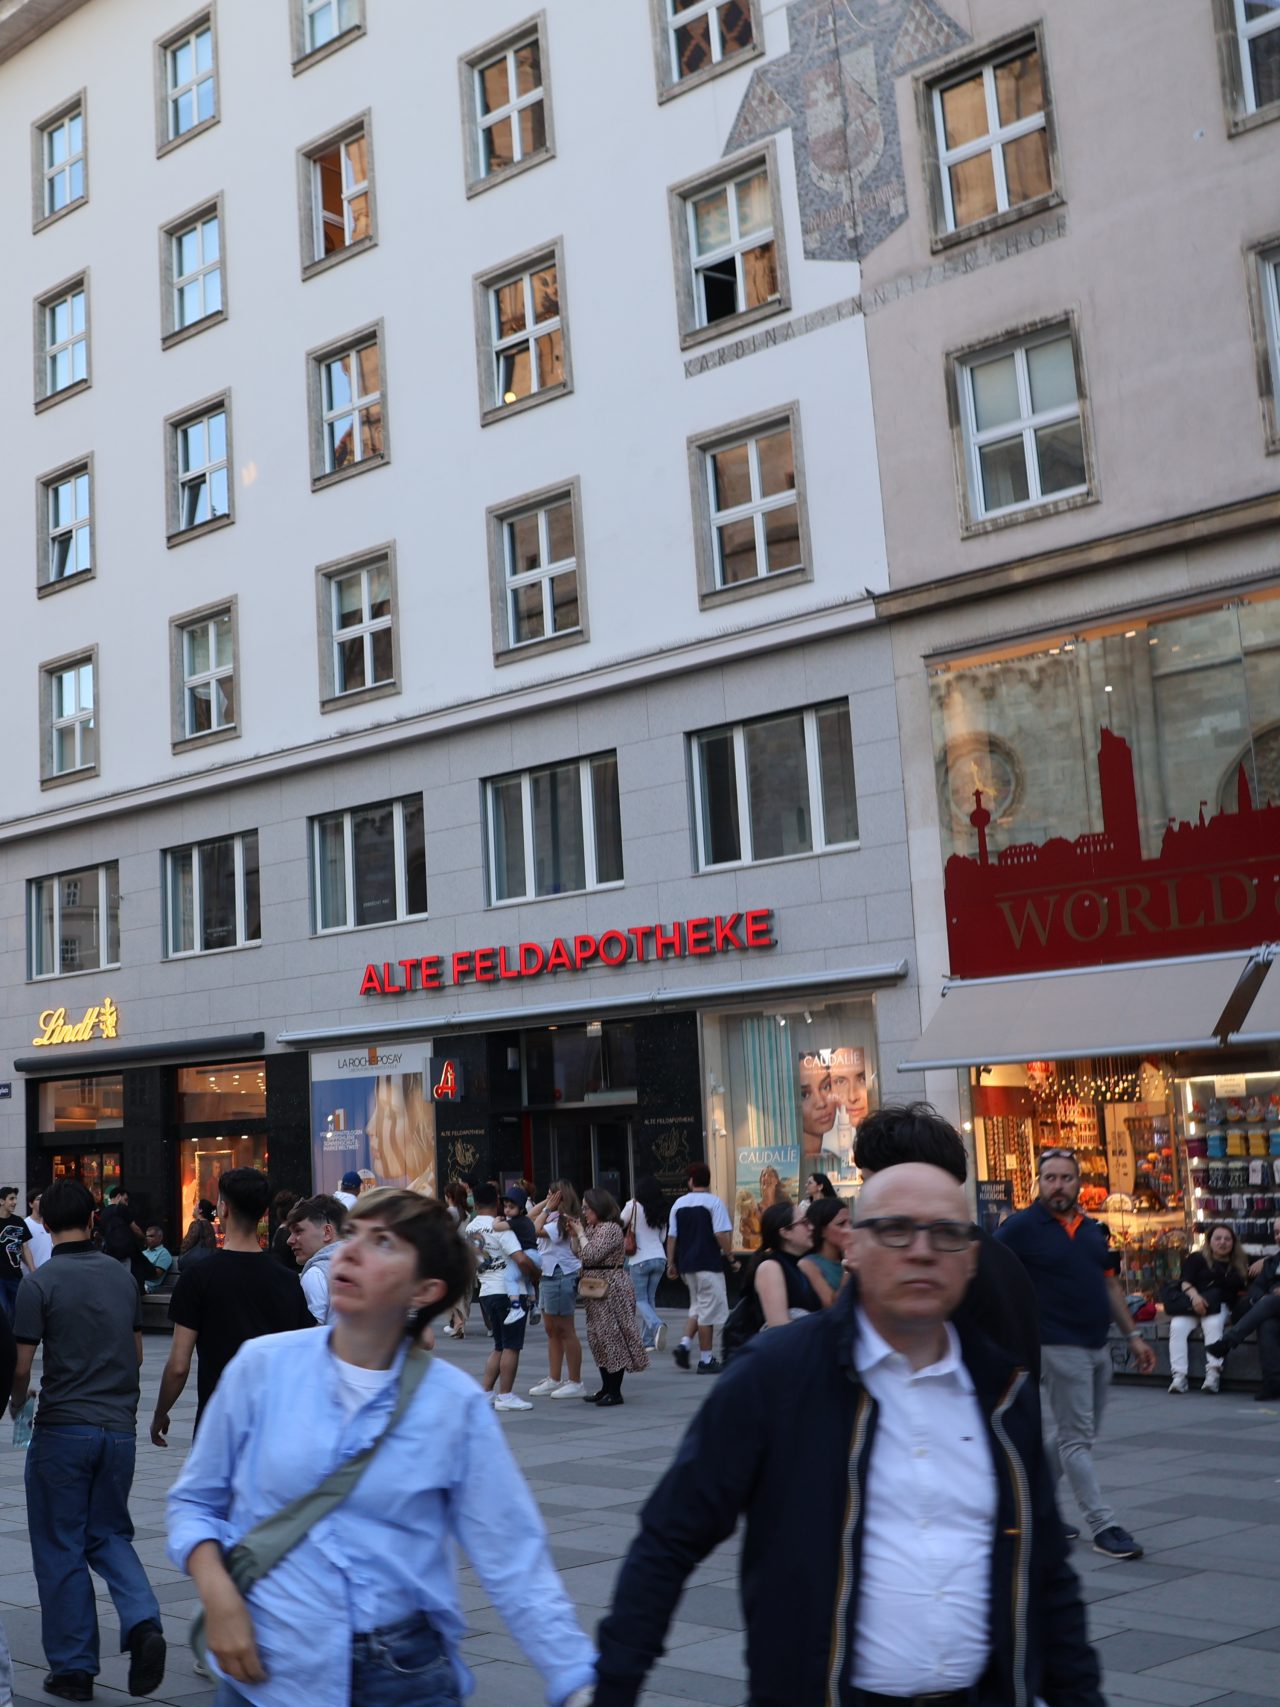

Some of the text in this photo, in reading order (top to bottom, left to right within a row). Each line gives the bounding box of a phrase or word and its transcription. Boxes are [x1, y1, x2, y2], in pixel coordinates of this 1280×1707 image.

[996, 870, 1258, 950] WORLD
[359, 908, 777, 996] ALTE FELDAPOTHEKE
[32, 1007, 100, 1047] Lindt
[338, 1059, 348, 1069] LA
[451, 1129, 485, 1137] FELDAPOTHEKE
